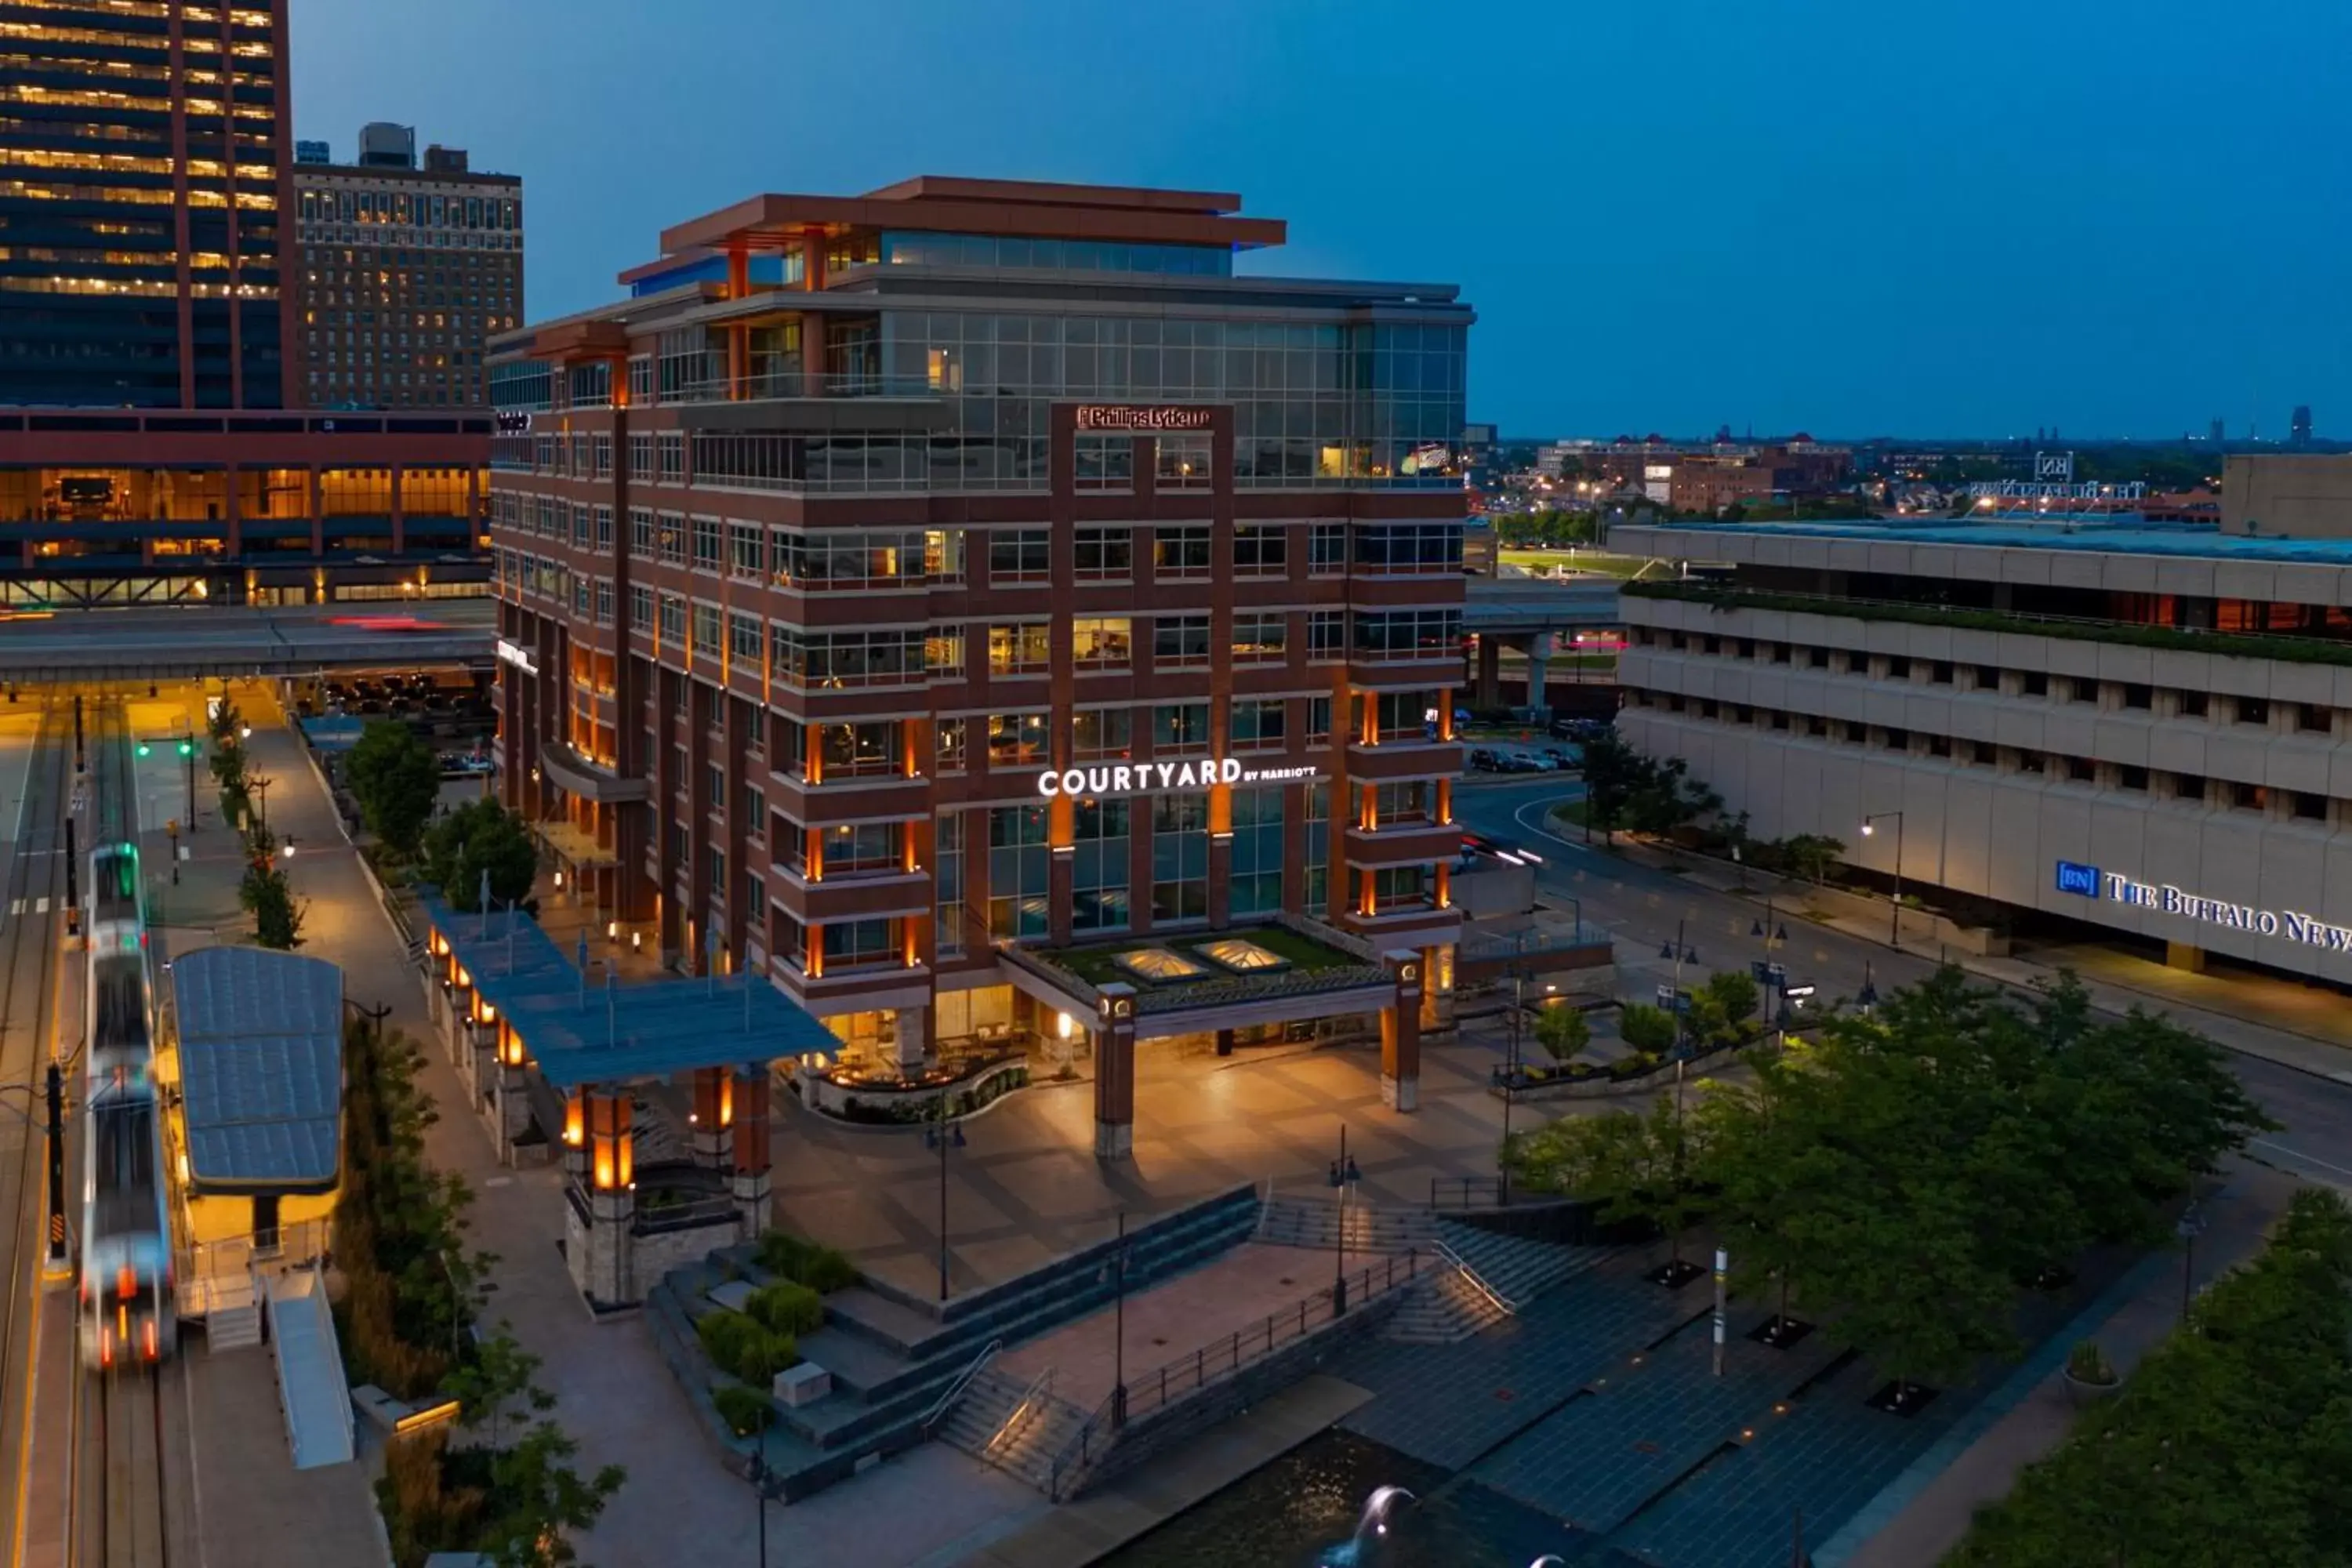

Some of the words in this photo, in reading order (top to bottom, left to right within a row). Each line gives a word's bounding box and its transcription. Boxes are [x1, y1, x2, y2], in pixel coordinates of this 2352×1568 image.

[1091, 406, 1149, 428] Phillips
[1149, 408, 1189, 429] Lytle
[1037, 757, 1241, 797] COURTYARD
[1243, 771, 1258, 782] BY
[1260, 766, 1317, 781] MARRIOTT
